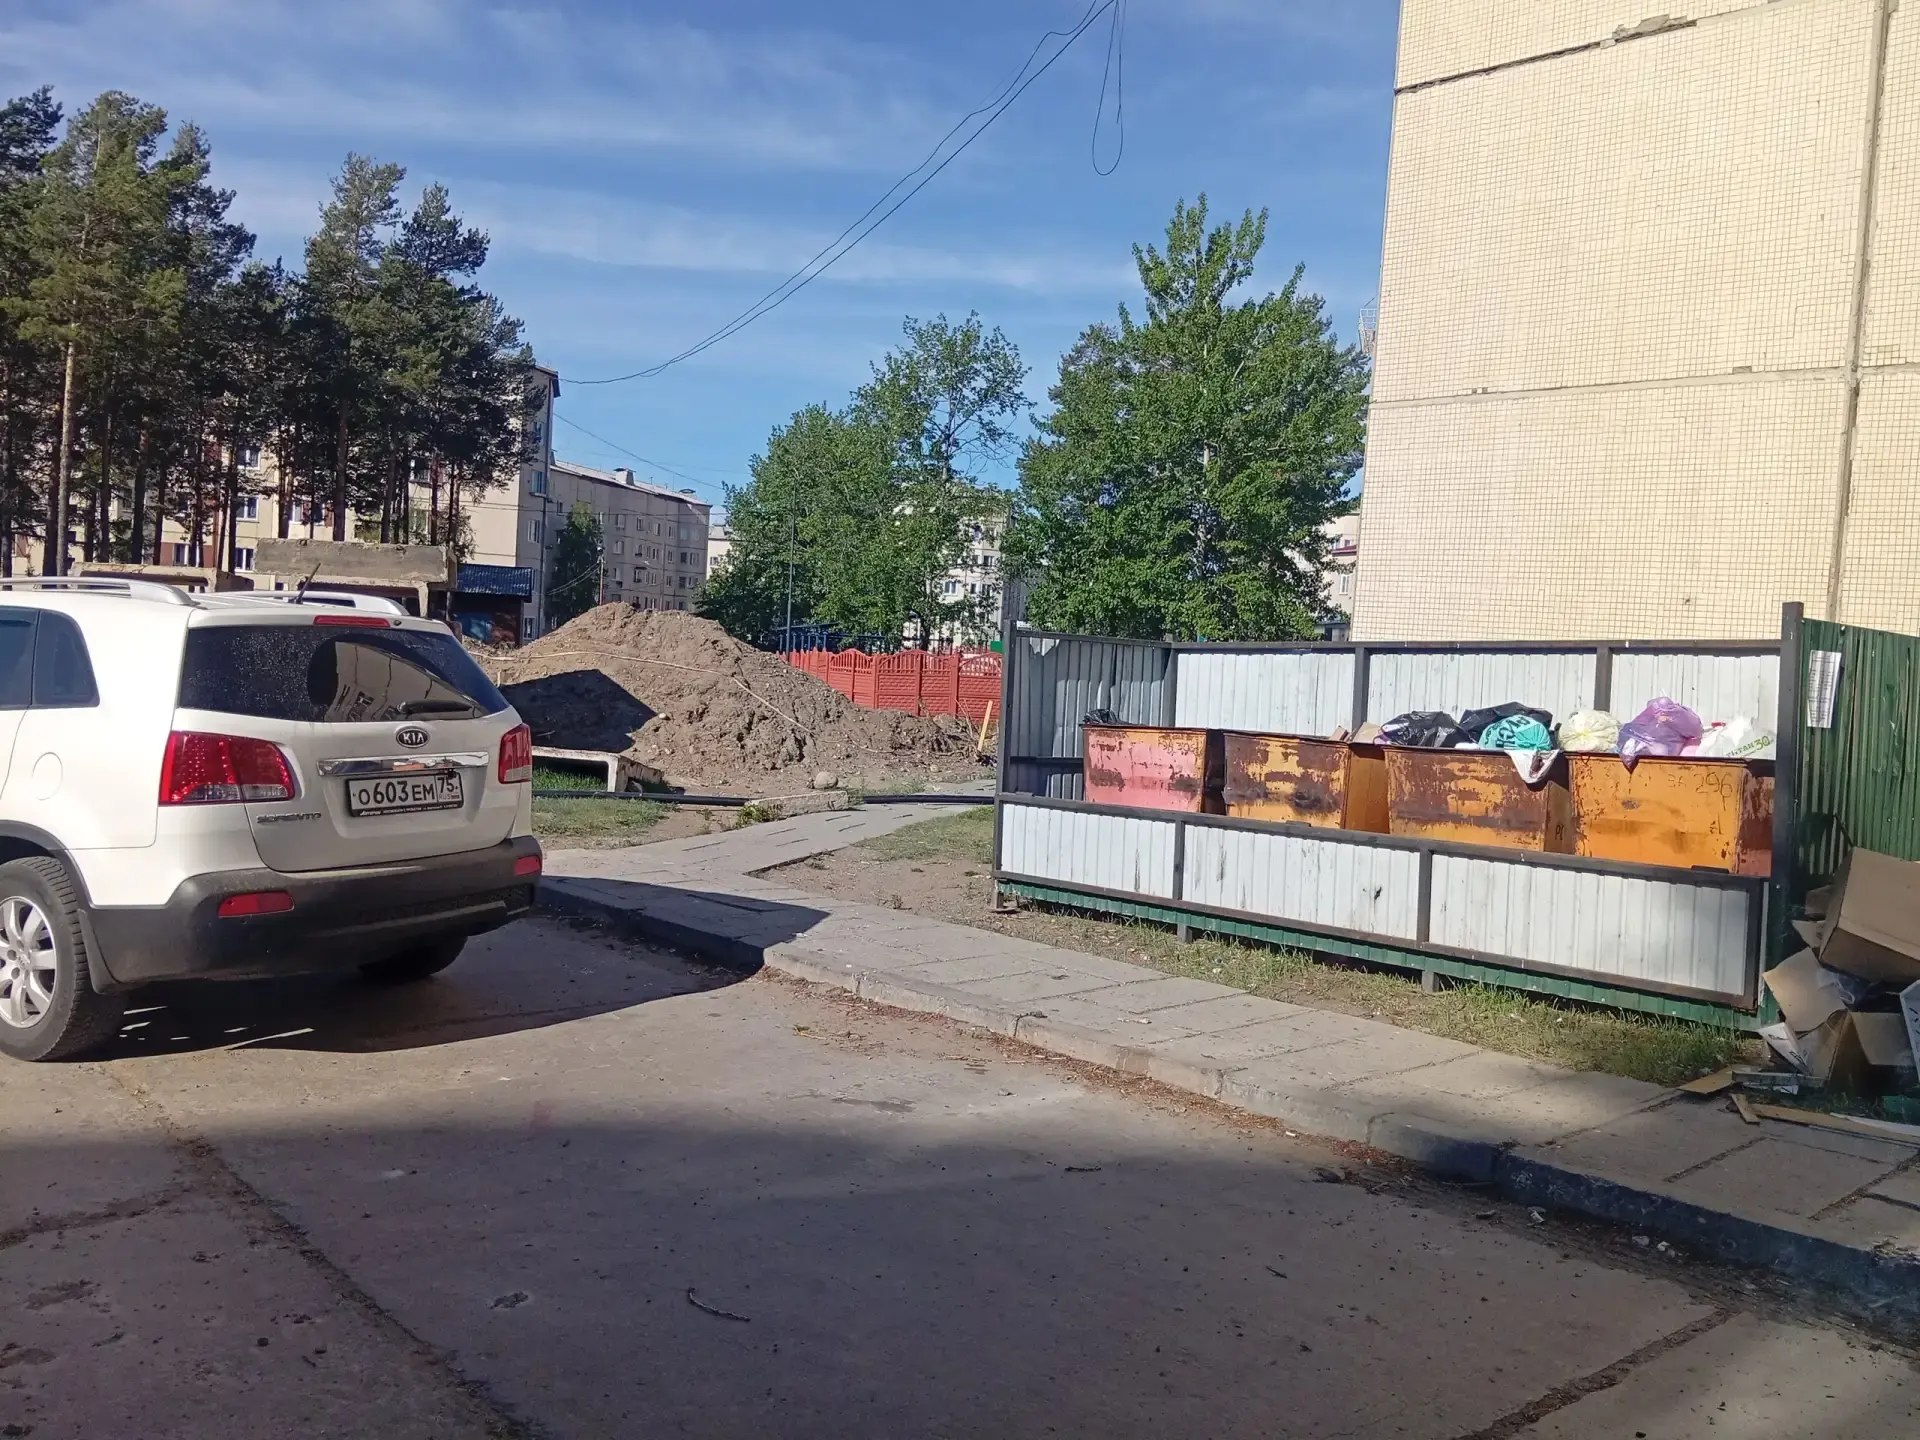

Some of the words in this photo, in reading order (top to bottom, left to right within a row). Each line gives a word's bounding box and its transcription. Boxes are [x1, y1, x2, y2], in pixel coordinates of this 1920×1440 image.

[402, 732, 425, 744] KIA
[1692, 771, 1733, 799] 296
[439, 793, 451, 801] RUS
